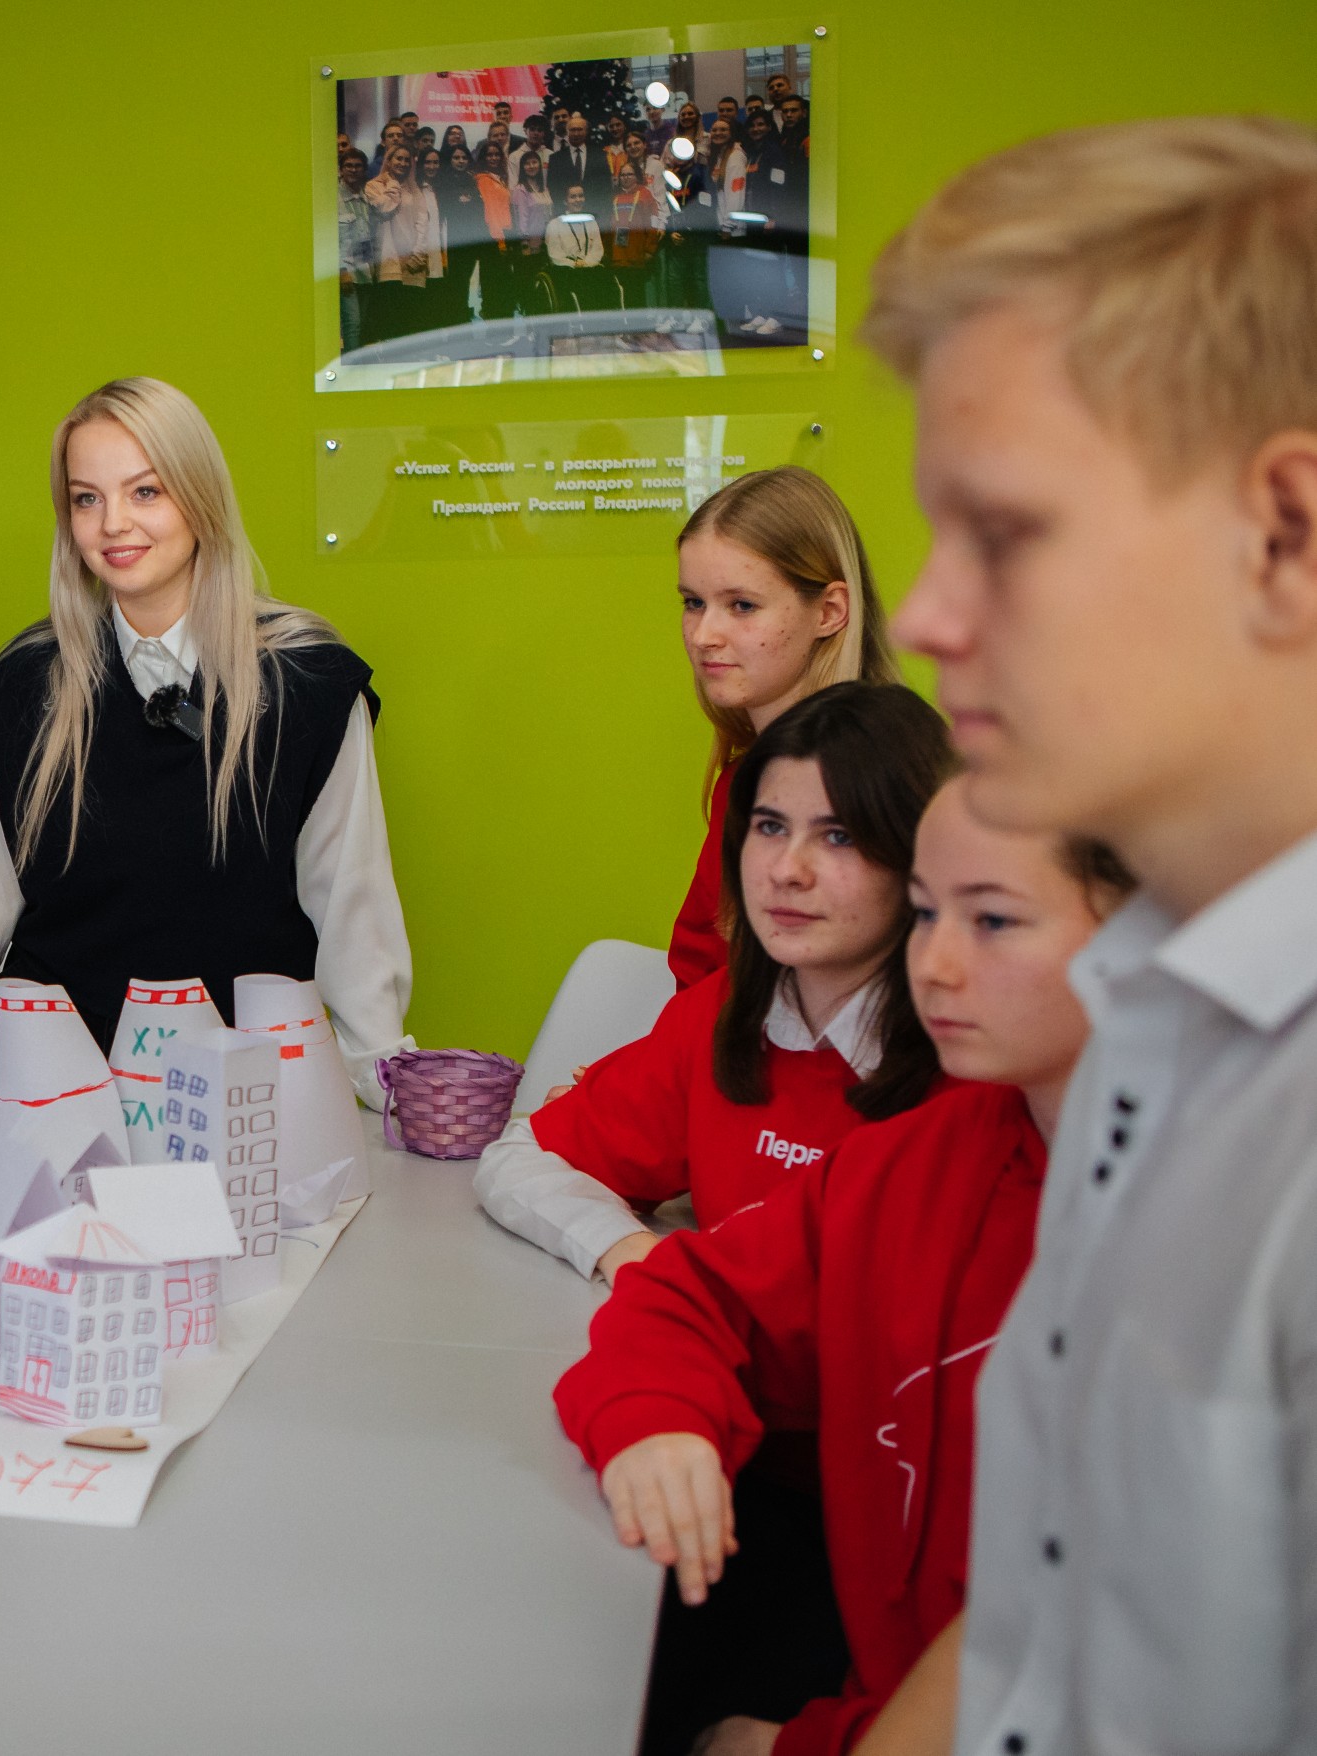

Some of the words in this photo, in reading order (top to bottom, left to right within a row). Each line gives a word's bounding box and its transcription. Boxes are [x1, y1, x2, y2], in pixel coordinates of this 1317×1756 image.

[394, 461, 451, 476] «Успех
[458, 459, 515, 474] России
[544, 460, 555, 472] в
[562, 457, 657, 473] раскрытии
[554, 478, 633, 492] молодого
[433, 499, 521, 517] Президент
[528, 497, 586, 512] России
[594, 495, 683, 512] Владимир
